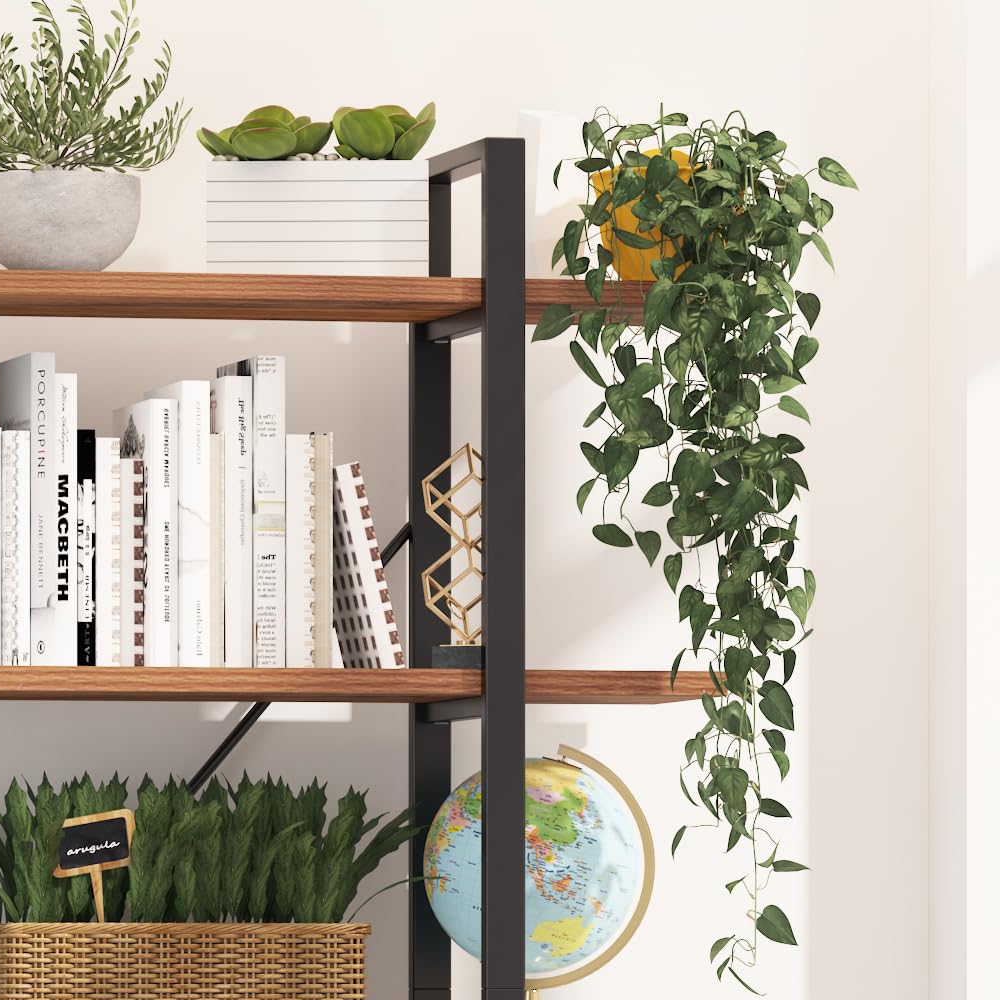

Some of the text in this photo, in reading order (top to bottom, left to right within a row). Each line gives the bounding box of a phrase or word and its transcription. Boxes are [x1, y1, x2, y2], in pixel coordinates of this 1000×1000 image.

[37, 369, 46, 480] PORCUPINE
[57, 474, 69, 601] MACBETH
[66, 840, 121, 856] arugula
